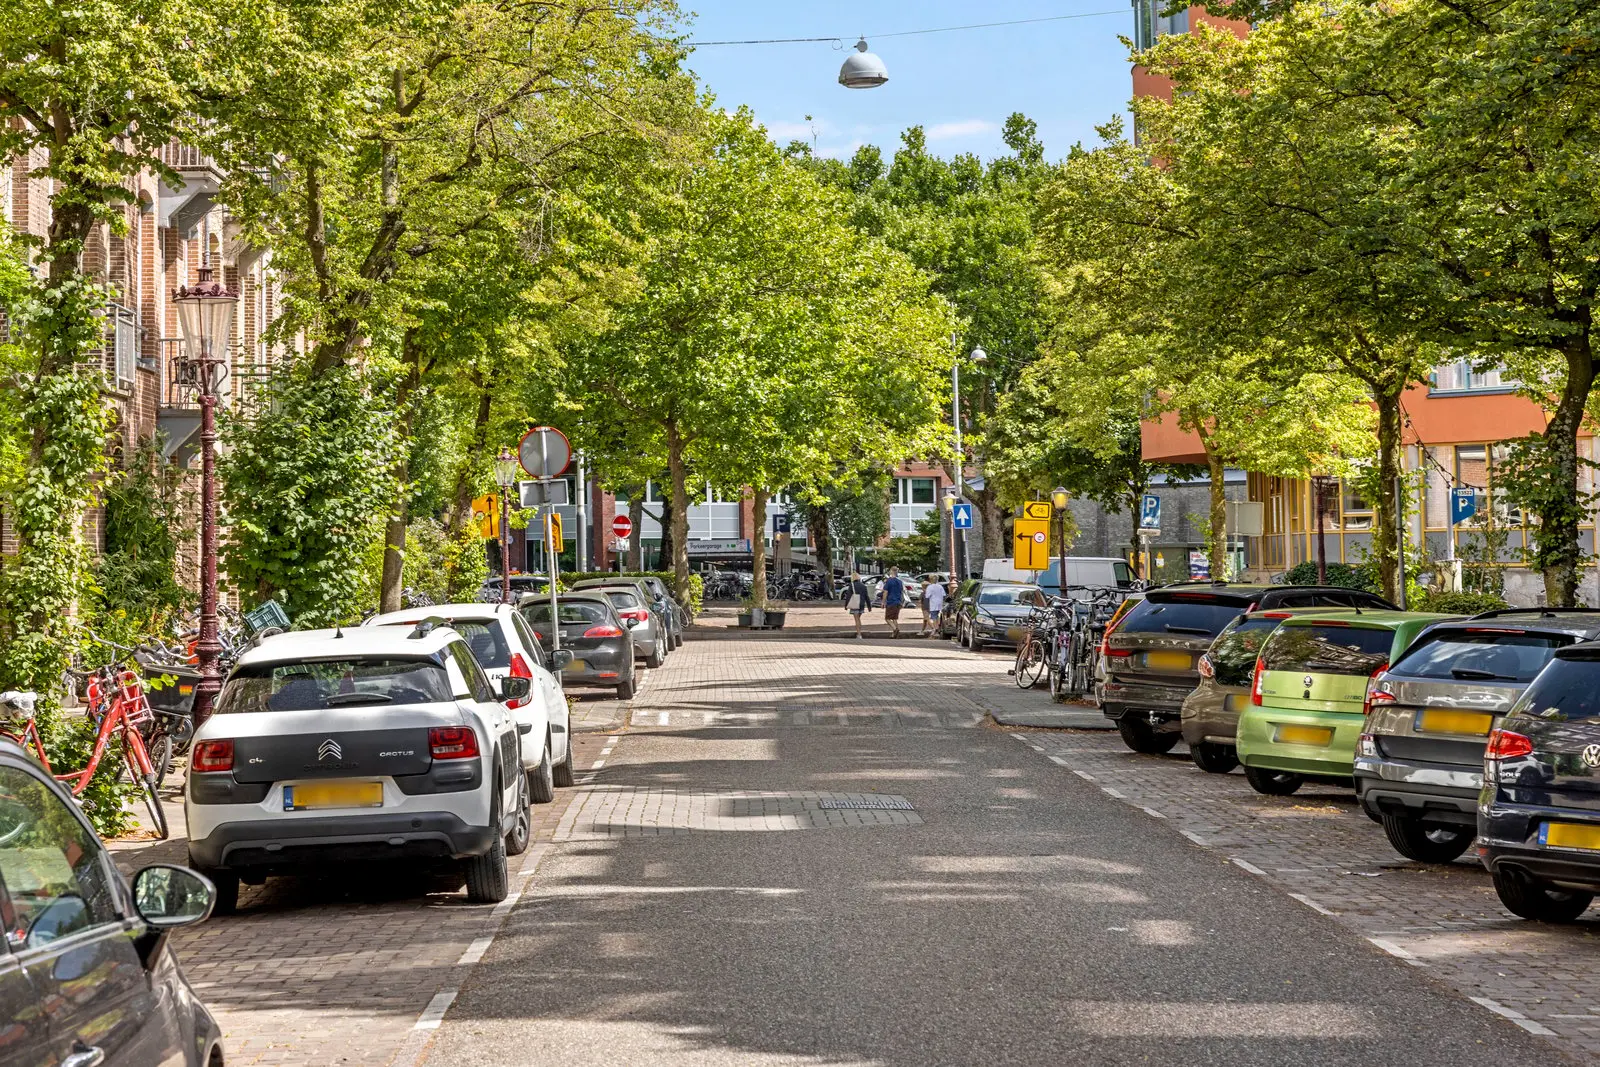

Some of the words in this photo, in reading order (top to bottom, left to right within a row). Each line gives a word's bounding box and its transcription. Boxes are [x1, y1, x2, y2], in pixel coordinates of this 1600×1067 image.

[1146, 497, 1157, 513] P
[1459, 498, 1468, 512] P
[776, 517, 786, 529] P
